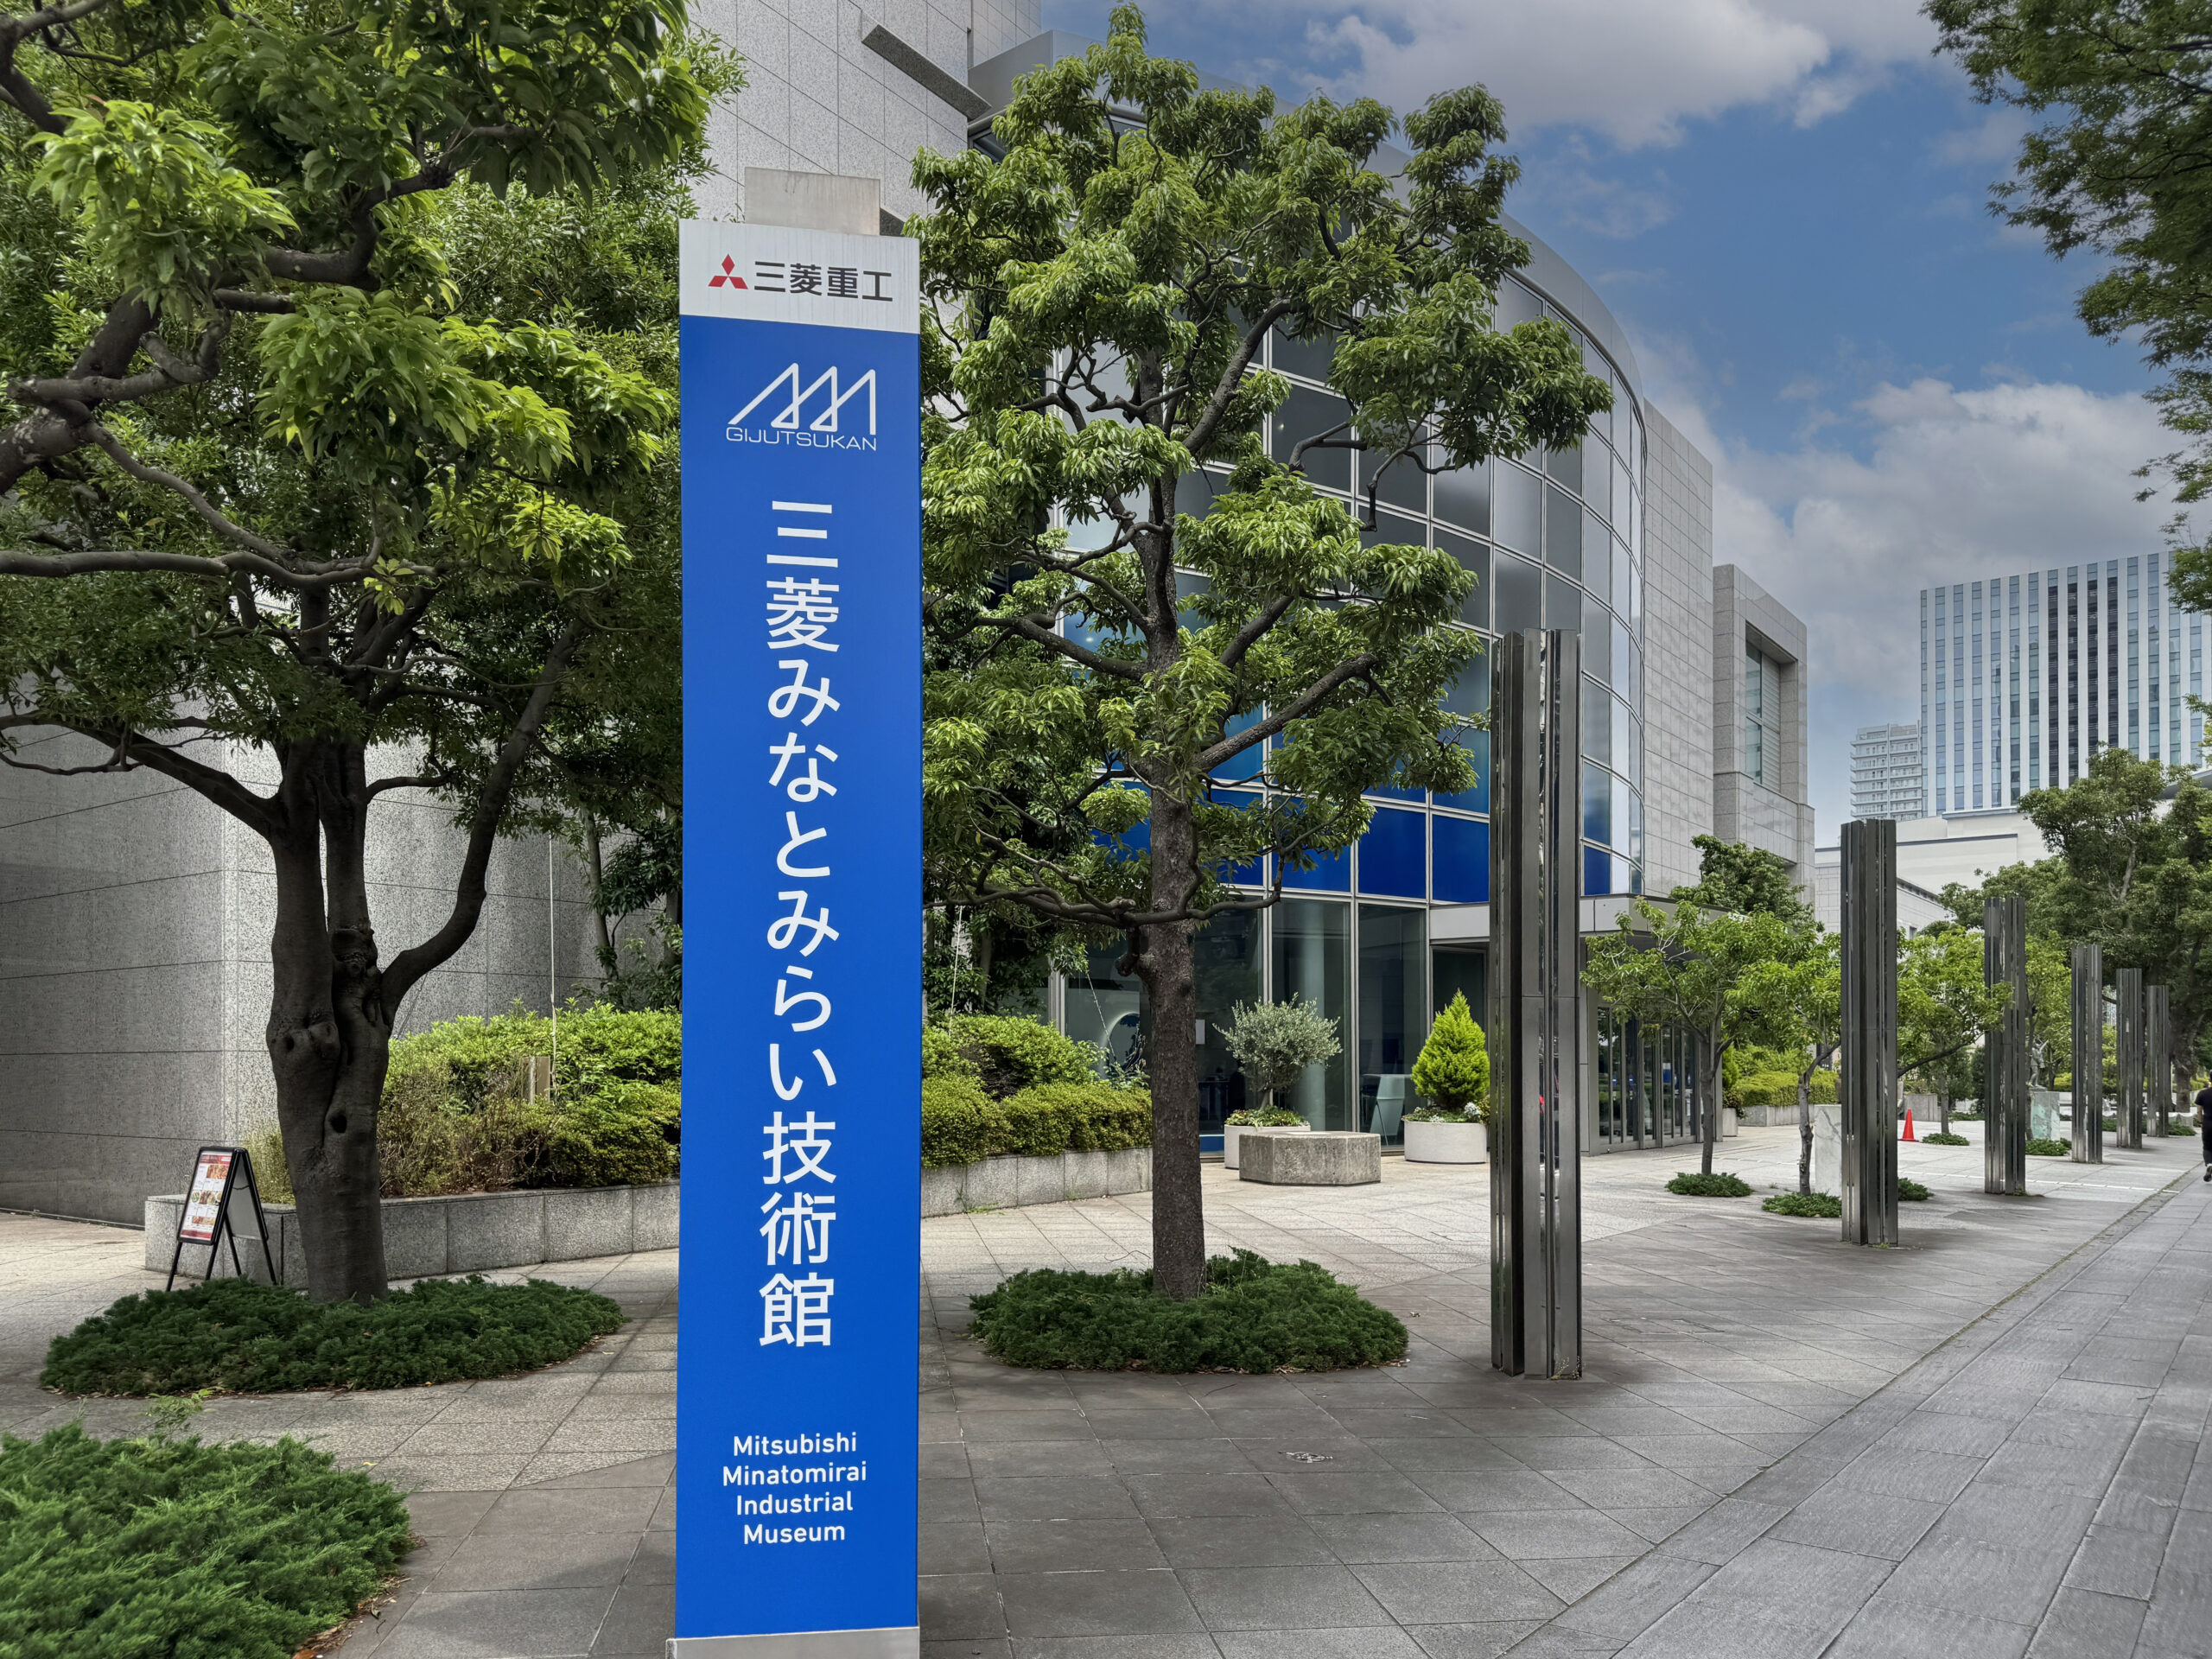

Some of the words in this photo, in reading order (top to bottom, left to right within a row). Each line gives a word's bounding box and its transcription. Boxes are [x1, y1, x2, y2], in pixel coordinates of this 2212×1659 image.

[754, 261, 893, 302] 三菱重工
[726, 426, 876, 452] GIJUTSUKAN
[760, 500, 841, 1347] 三菱みなとみらい技術館
[733, 1432, 857, 1457] Mitsubishi
[722, 1461, 867, 1486] Minatomirai
[736, 1491, 854, 1516] Industrial
[743, 1523, 846, 1545] Museum
